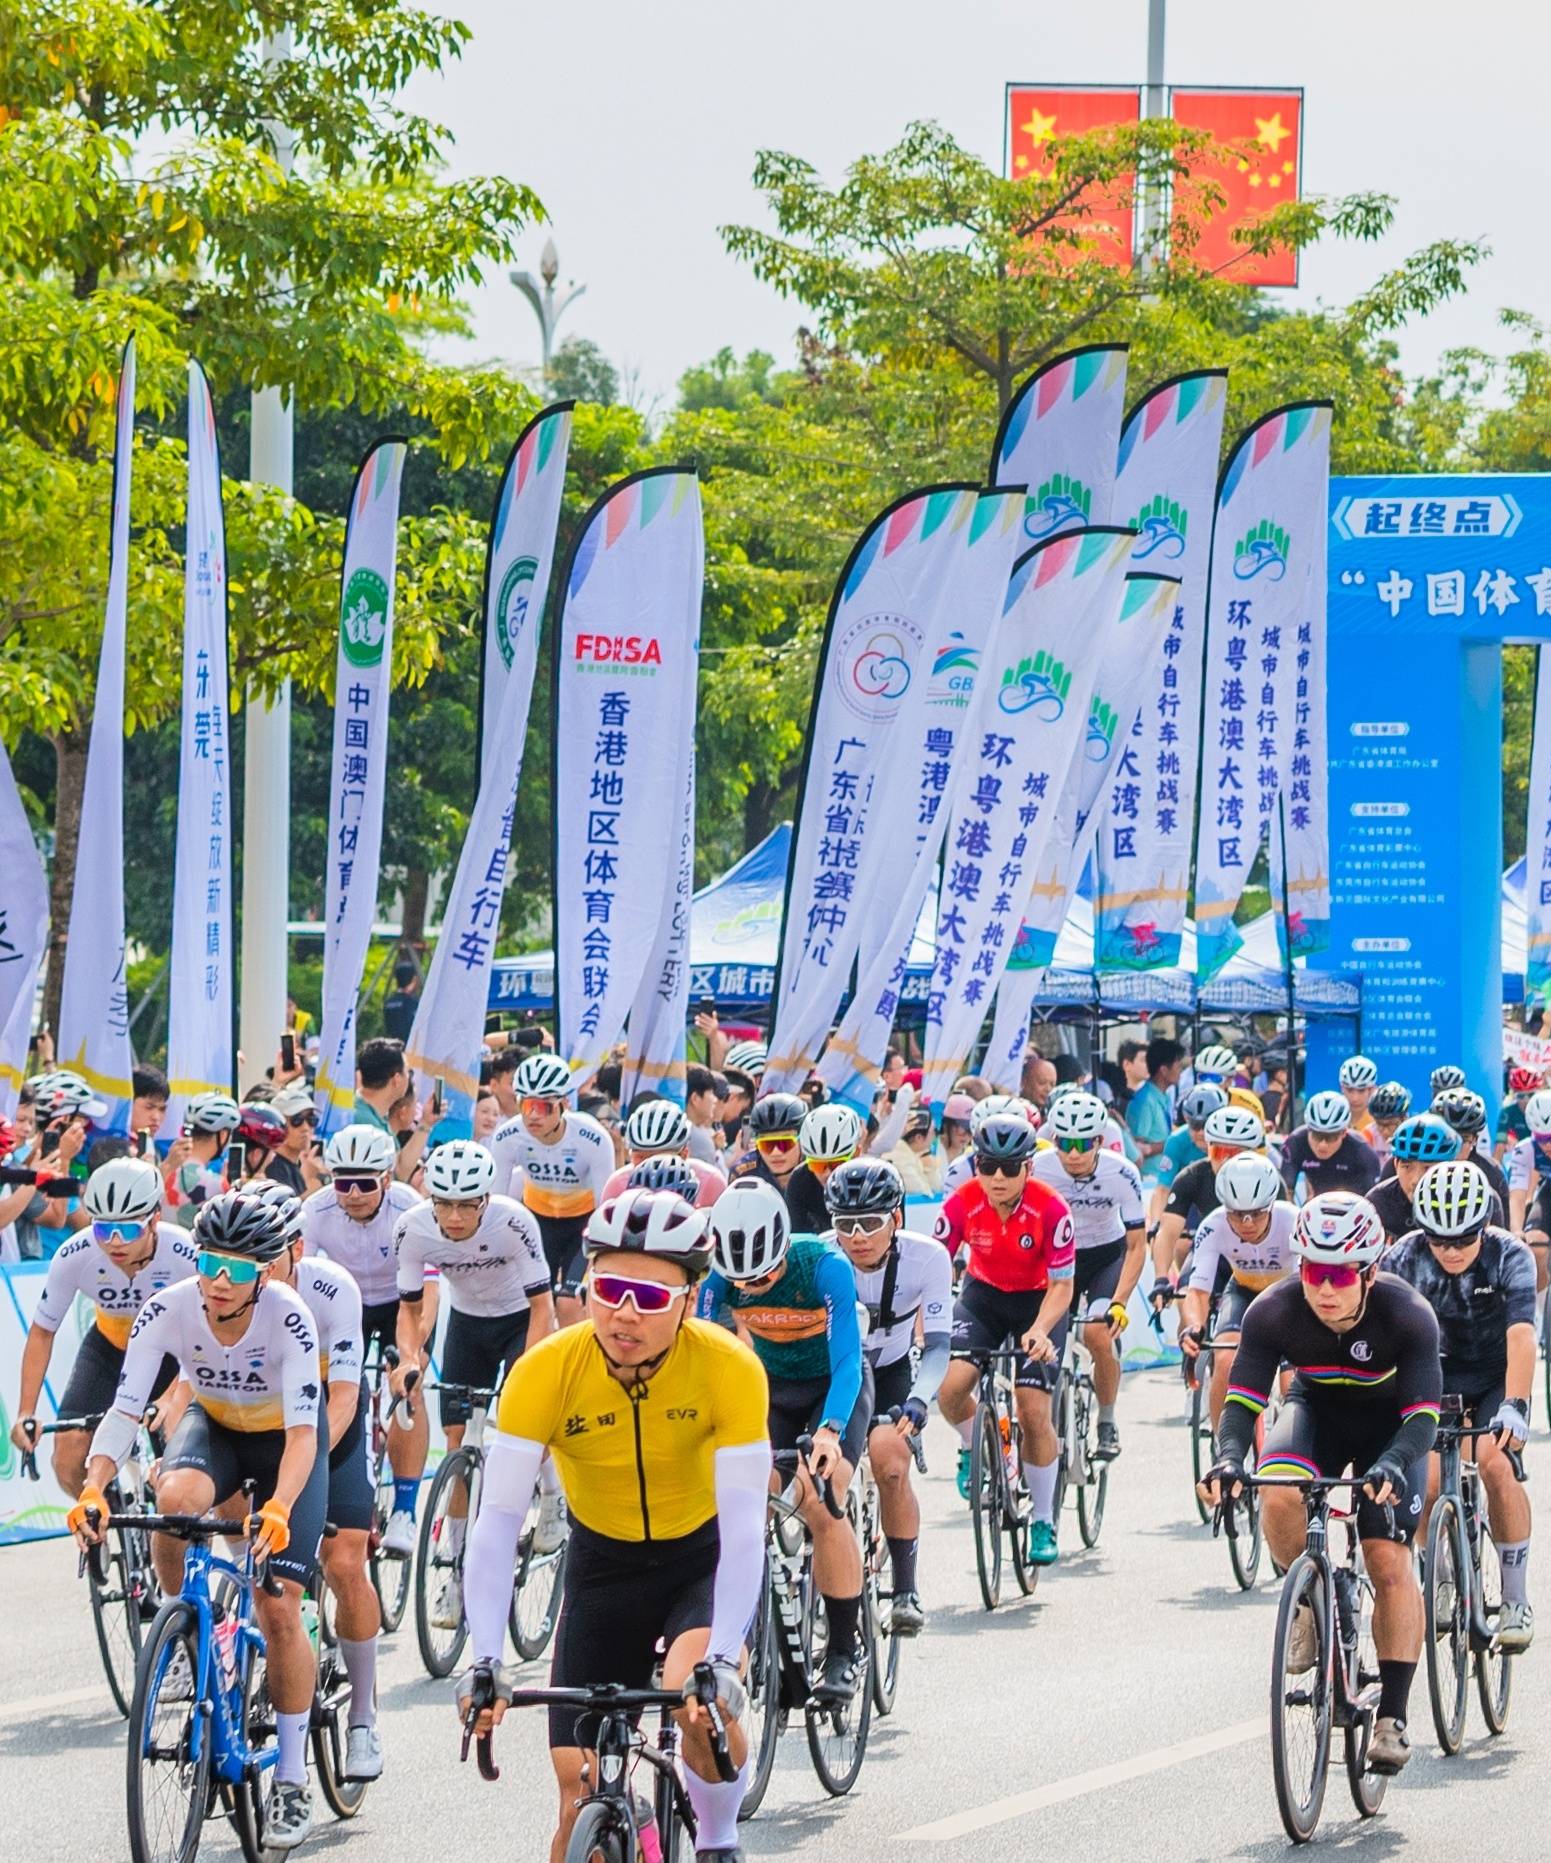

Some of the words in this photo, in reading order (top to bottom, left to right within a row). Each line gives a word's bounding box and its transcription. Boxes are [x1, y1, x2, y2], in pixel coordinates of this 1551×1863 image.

[1364, 501, 1493, 535] 起终点
[948, 676, 975, 691] GB
[1215, 599, 1252, 868] 环粤港澳大湾区
[1111, 705, 1143, 860] 大湾区
[916, 727, 955, 866] 粤港澳
[926, 732, 1017, 1027] 环粤港澳大湾区
[962, 771, 1050, 1008] 城市自行车挑战赛
[495, 1126, 520, 1143] OSSA
[578, 1127, 601, 1147] OSSA
[527, 1160, 579, 1178] OSSA
[60, 1238, 91, 1260] OSSA
[313, 1278, 339, 1302] OSSA
[130, 1301, 168, 1341] OSSA
[283, 1311, 316, 1355] OSSA
[194, 1366, 266, 1386] OSSA
[666, 1407, 699, 1421] EVR
[1501, 1548, 1528, 1567] EF
